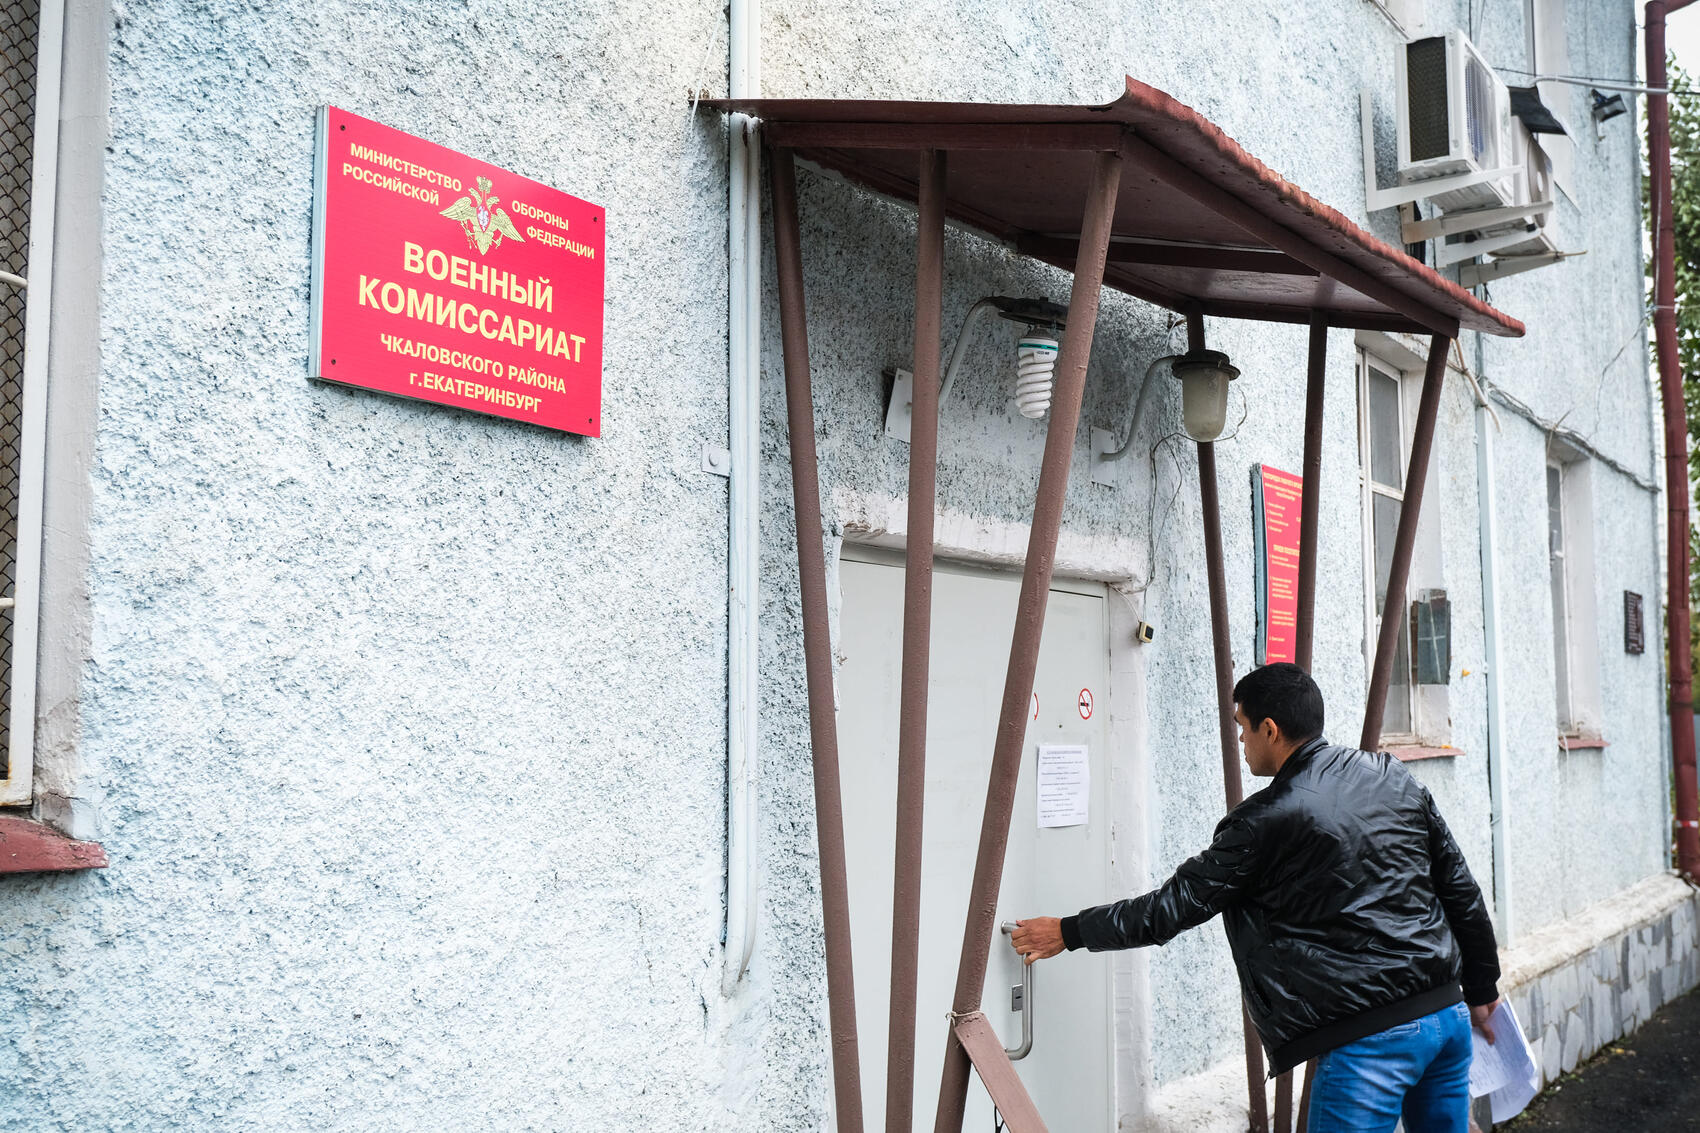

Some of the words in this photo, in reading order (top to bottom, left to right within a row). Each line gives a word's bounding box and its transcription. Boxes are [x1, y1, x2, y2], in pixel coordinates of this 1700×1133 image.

[343, 163, 440, 206] РОССИЙСКОЙ
[526, 226, 595, 259] ФЕДЕРАЦИИ
[350, 143, 462, 192] МИНИСТЕРСТВО
[511, 200, 569, 231] ОБОРОНЫ
[358, 275, 586, 363] КОМИССАРИАТ
[403, 241, 553, 313] ВОЕННЫЙ
[380, 334, 504, 377] ЧКАЛОВСКОГО
[508, 365, 567, 394] РАЙОНА
